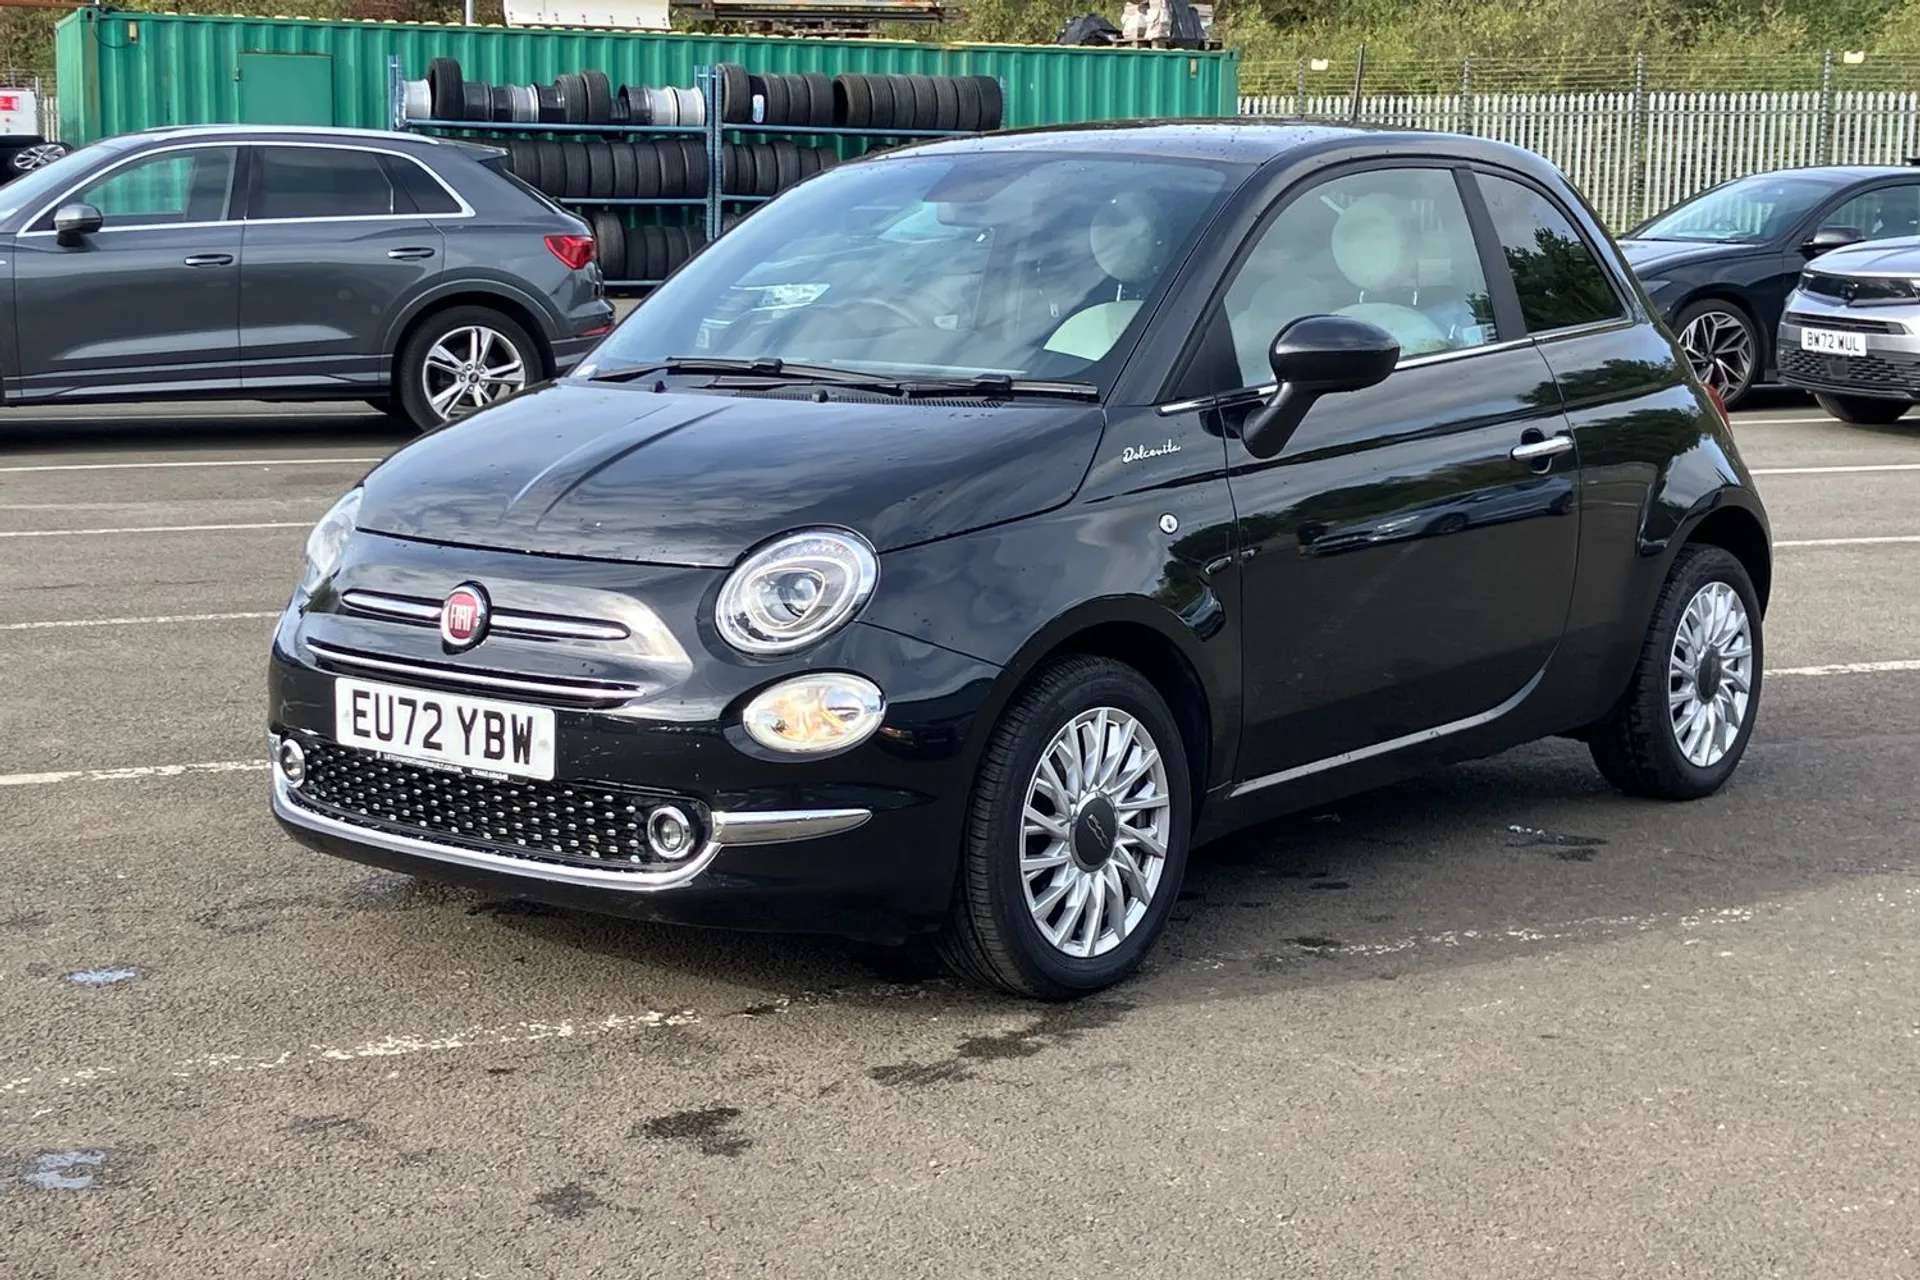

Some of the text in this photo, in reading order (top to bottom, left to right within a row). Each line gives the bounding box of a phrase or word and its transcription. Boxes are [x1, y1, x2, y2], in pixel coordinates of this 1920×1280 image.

[1807, 331, 1860, 352] BW72 WUL
[1122, 438, 1182, 464] Dolcevita
[450, 603, 475, 631] FIAT
[352, 689, 533, 765] EU72 YBW
